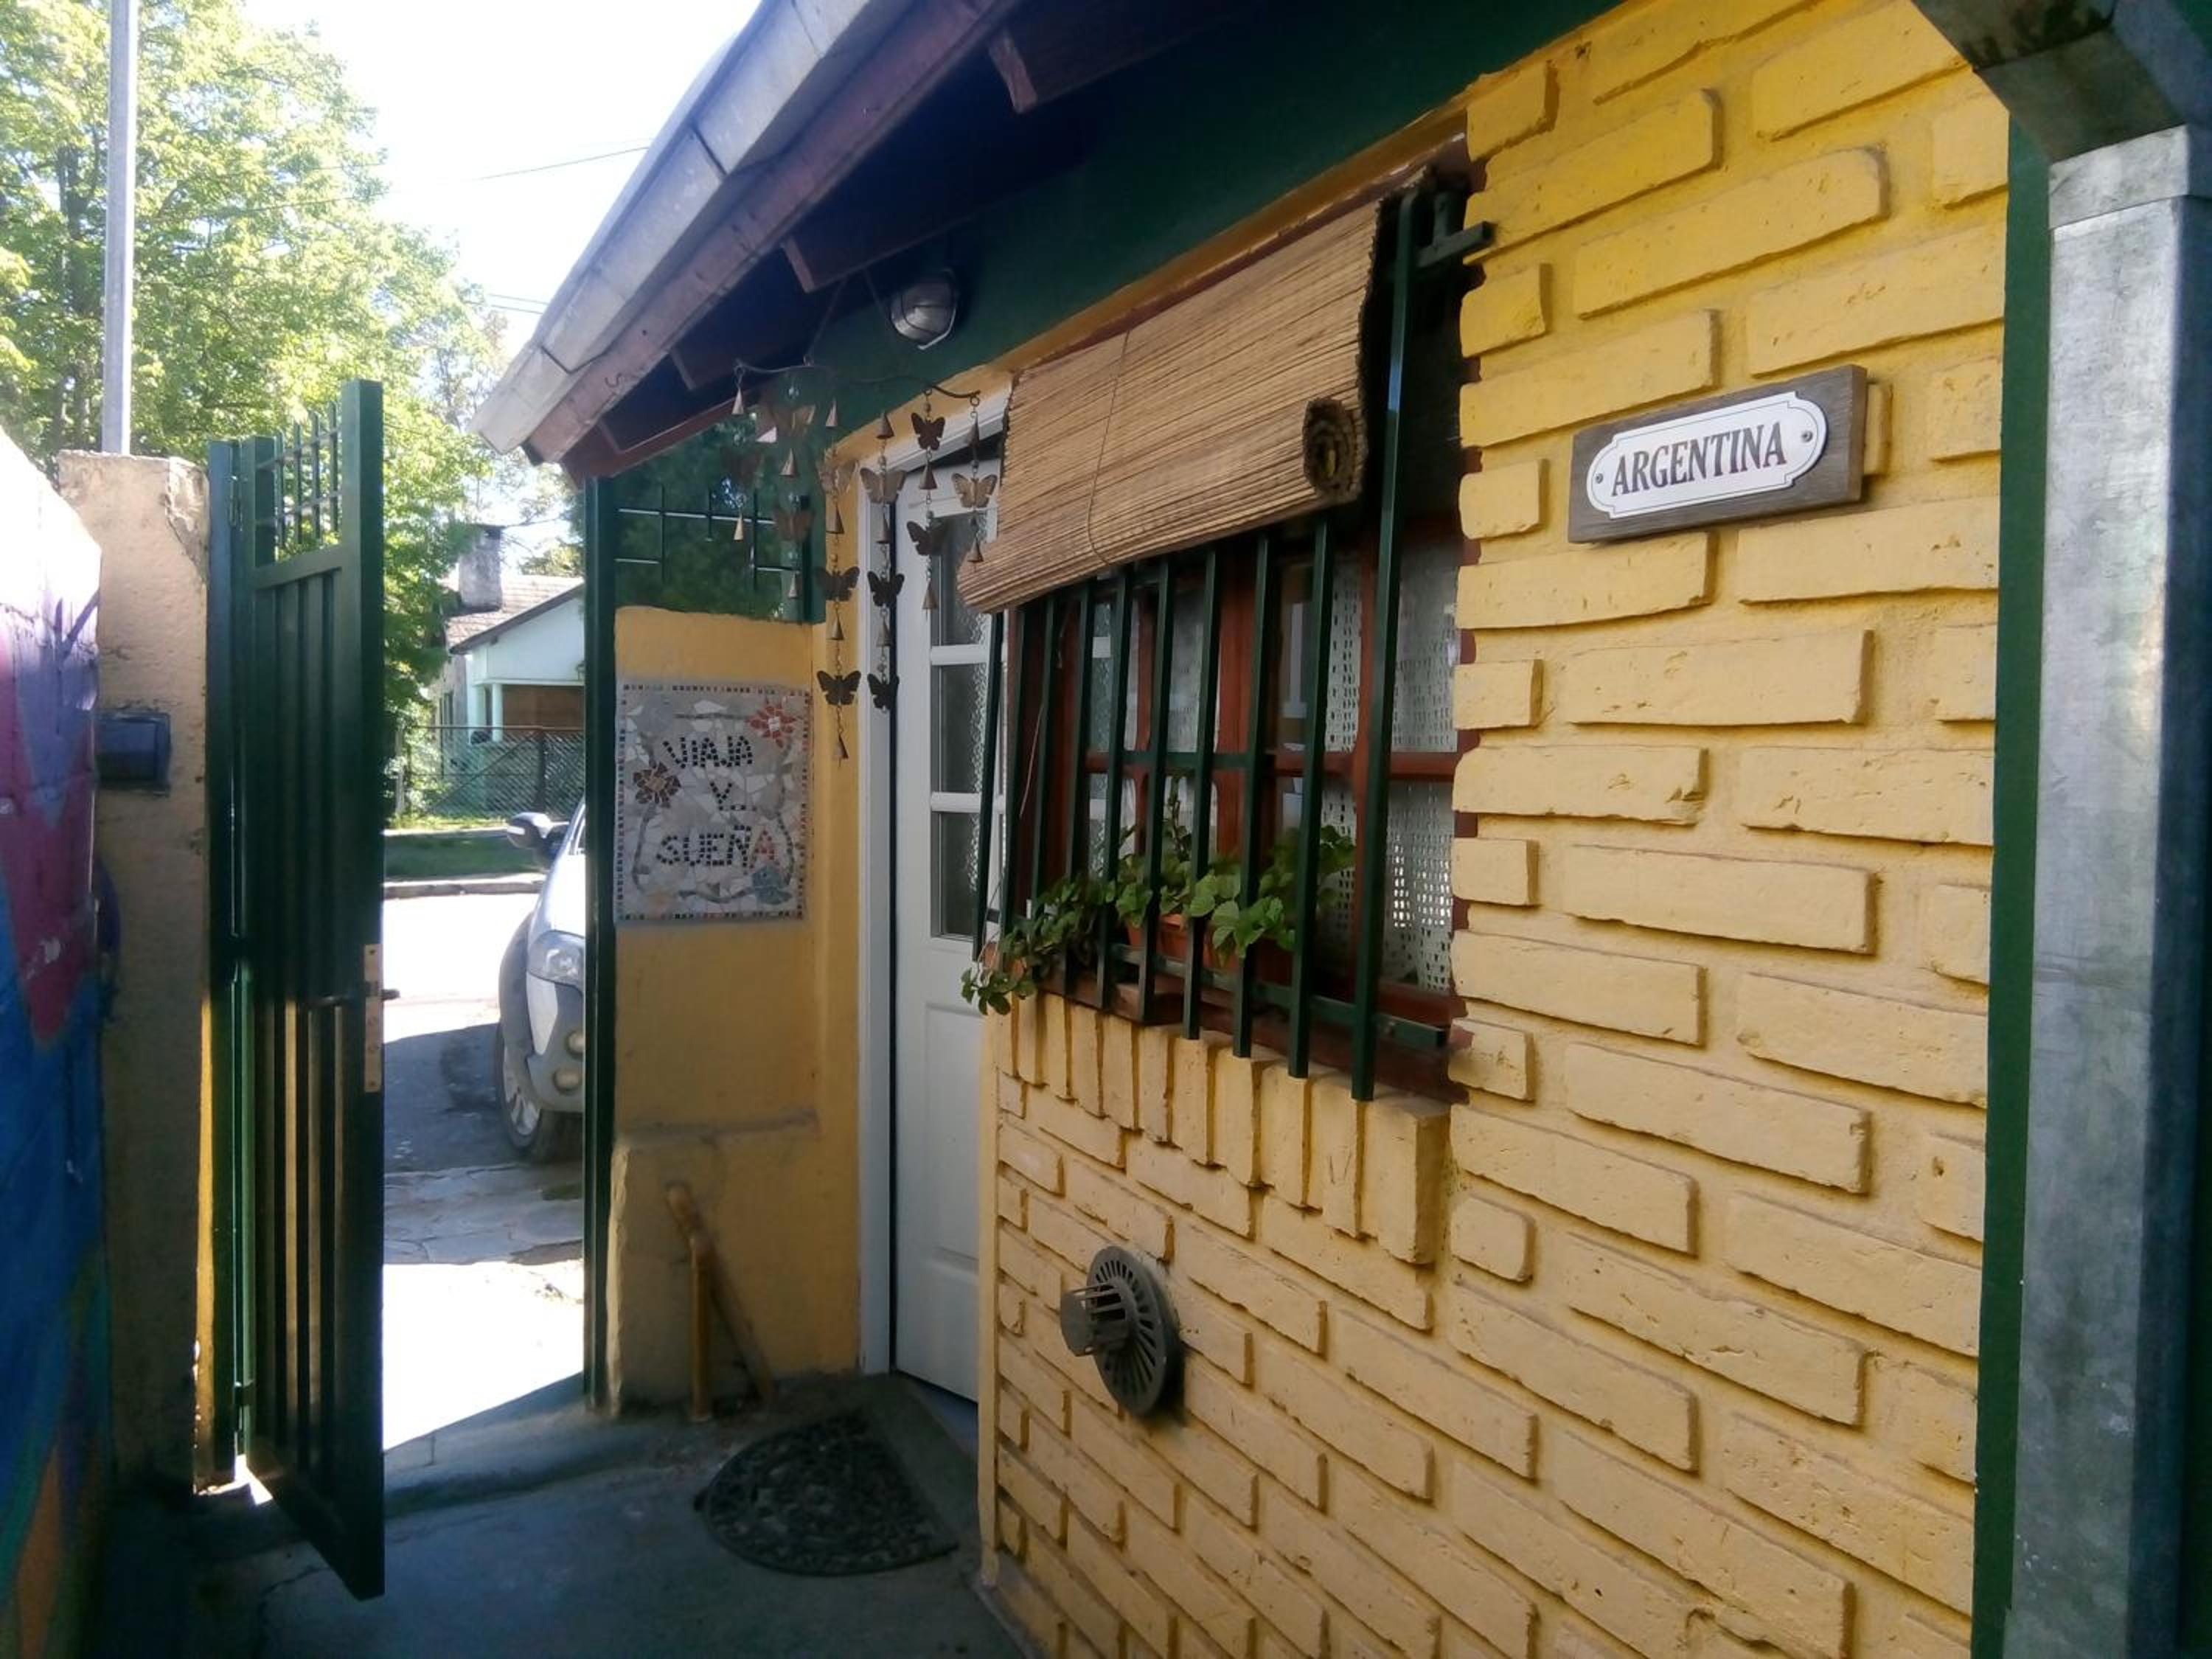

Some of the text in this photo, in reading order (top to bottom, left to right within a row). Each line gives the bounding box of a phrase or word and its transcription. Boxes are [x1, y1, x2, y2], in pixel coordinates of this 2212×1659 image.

[1611, 420, 1787, 497] ARGENTINA
[662, 735, 754, 768] VIAJA
[709, 782, 733, 811] Y
